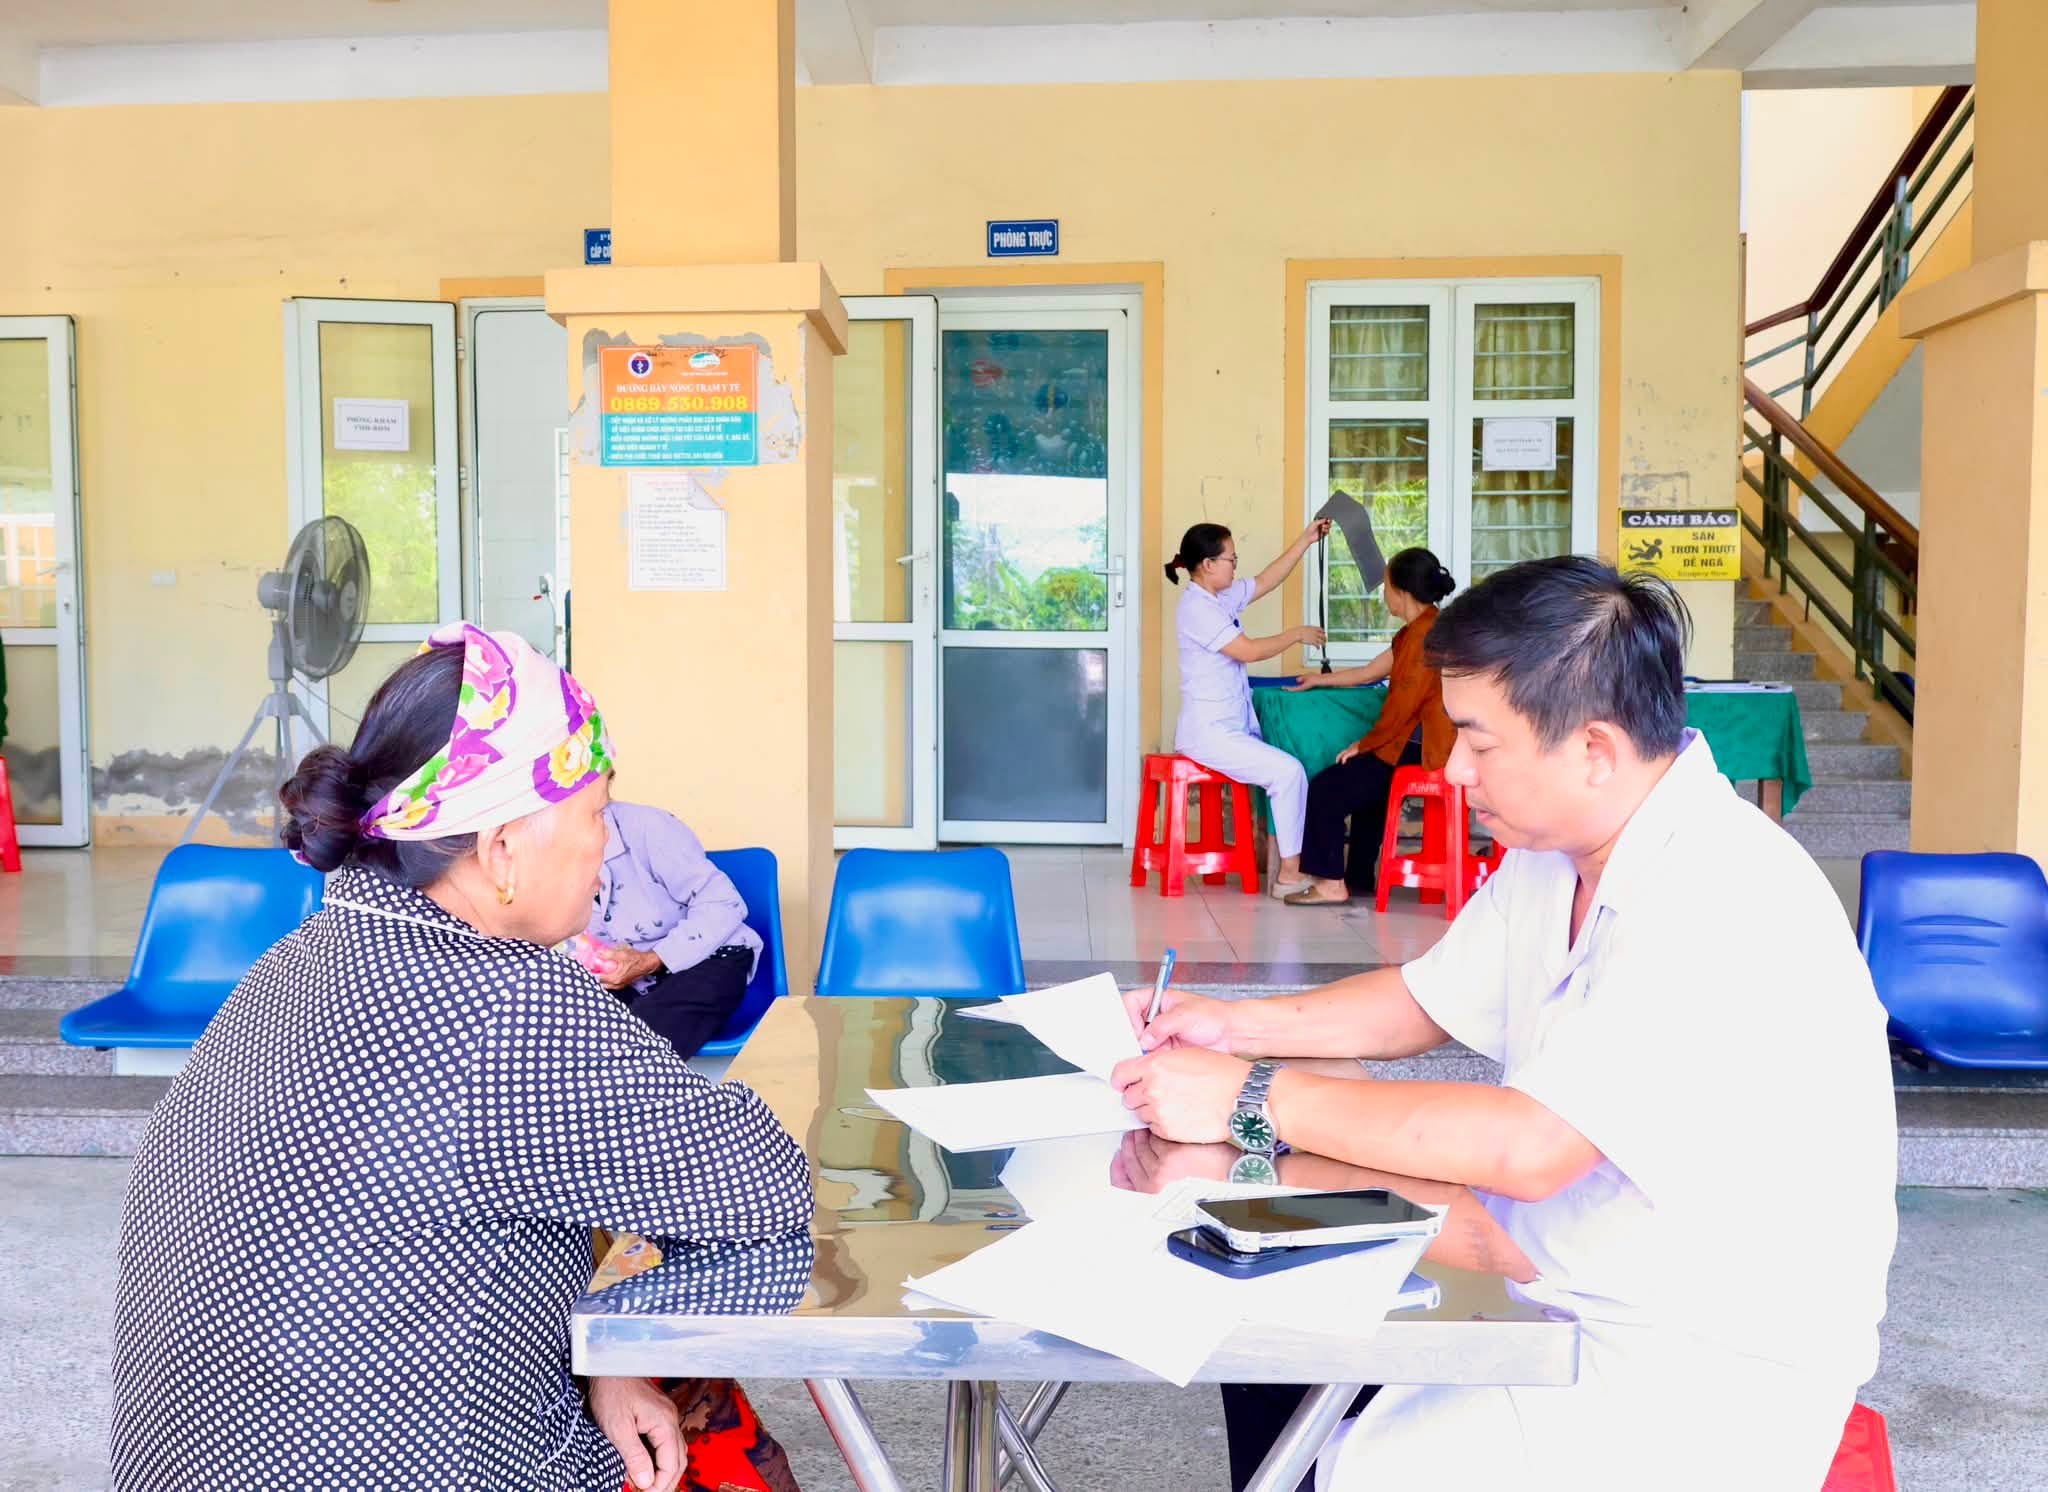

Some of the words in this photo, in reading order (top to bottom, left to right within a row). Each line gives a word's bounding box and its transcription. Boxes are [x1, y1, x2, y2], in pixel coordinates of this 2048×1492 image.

[993, 228, 1026, 248] PHÒNG
[1028, 229, 1053, 250] TRỰC
[610, 396, 749, 412] 0869.530.908
[1628, 511, 1685, 526] CẢNH
[1689, 511, 1731, 526] BÁO
